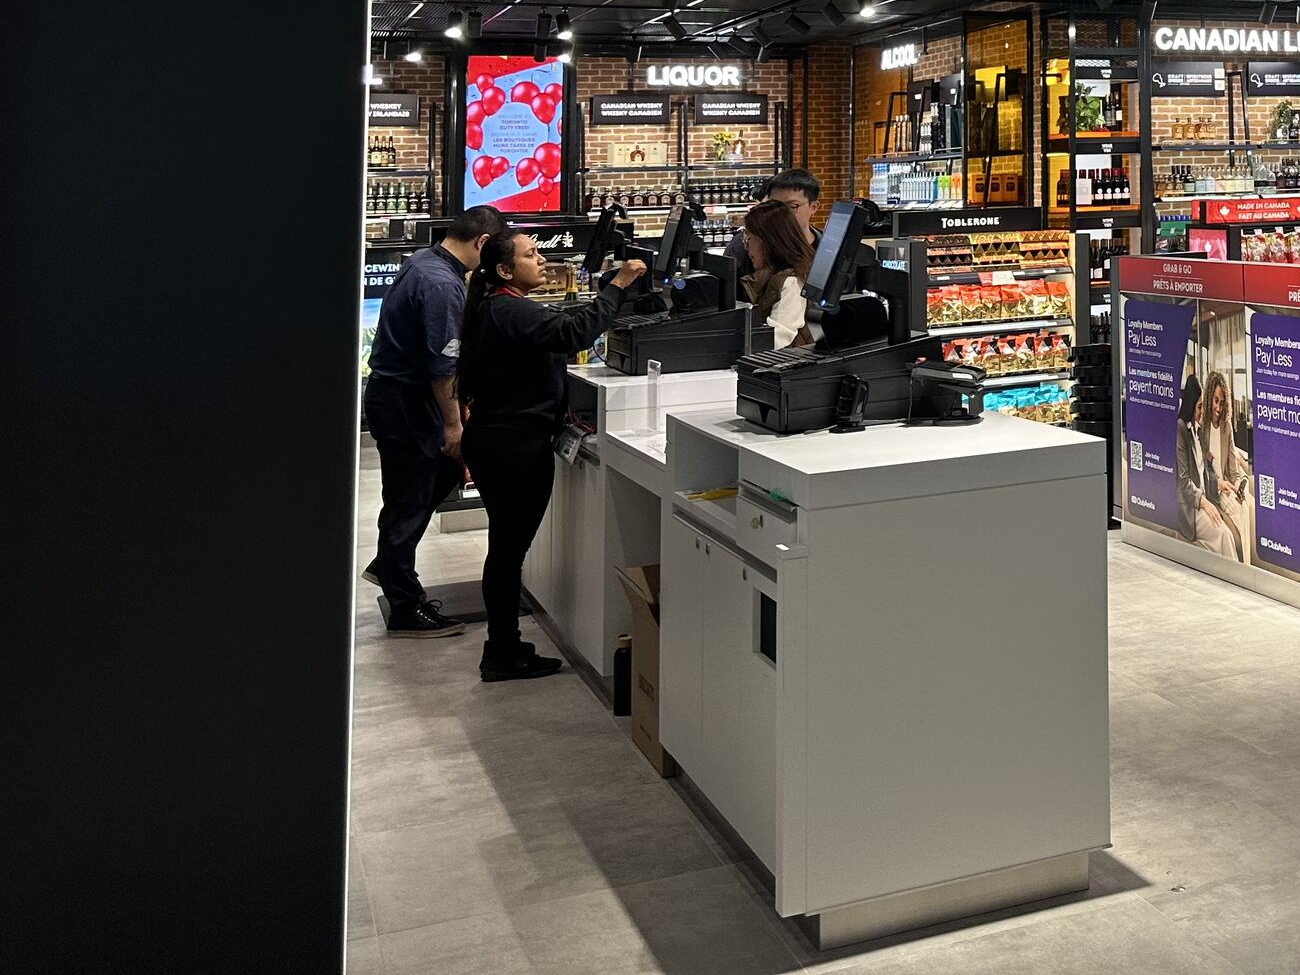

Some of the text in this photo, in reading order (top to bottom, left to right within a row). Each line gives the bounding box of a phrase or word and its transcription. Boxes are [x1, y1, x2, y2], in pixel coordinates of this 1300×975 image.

[1154, 27, 1278, 52] CANADIAN
[880, 43, 918, 70] ALCOOL
[646, 65, 741, 87] LIQUOR
[1263, 211, 1289, 219] CANADA
[364, 263, 403, 273] CEWIN
[1162, 263, 1192, 274] GRAB & GO
[370, 277, 383, 286] DE
[1153, 279, 1203, 293] PRÊTS À EMPORTER
[1128, 329, 1157, 347] Pay Less
[1254, 334, 1300, 350] Loyalty Members
[1255, 347, 1293, 368] Pay Less
[1128, 366, 1137, 376] Les
[1137, 369, 1157, 379] membres
[1129, 379, 1174, 398] payent moins
[1256, 388, 1266, 400] Les
[1267, 393, 1293, 405] membres
[1257, 404, 1287, 422] payent
[1286, 489, 1298, 500] today
